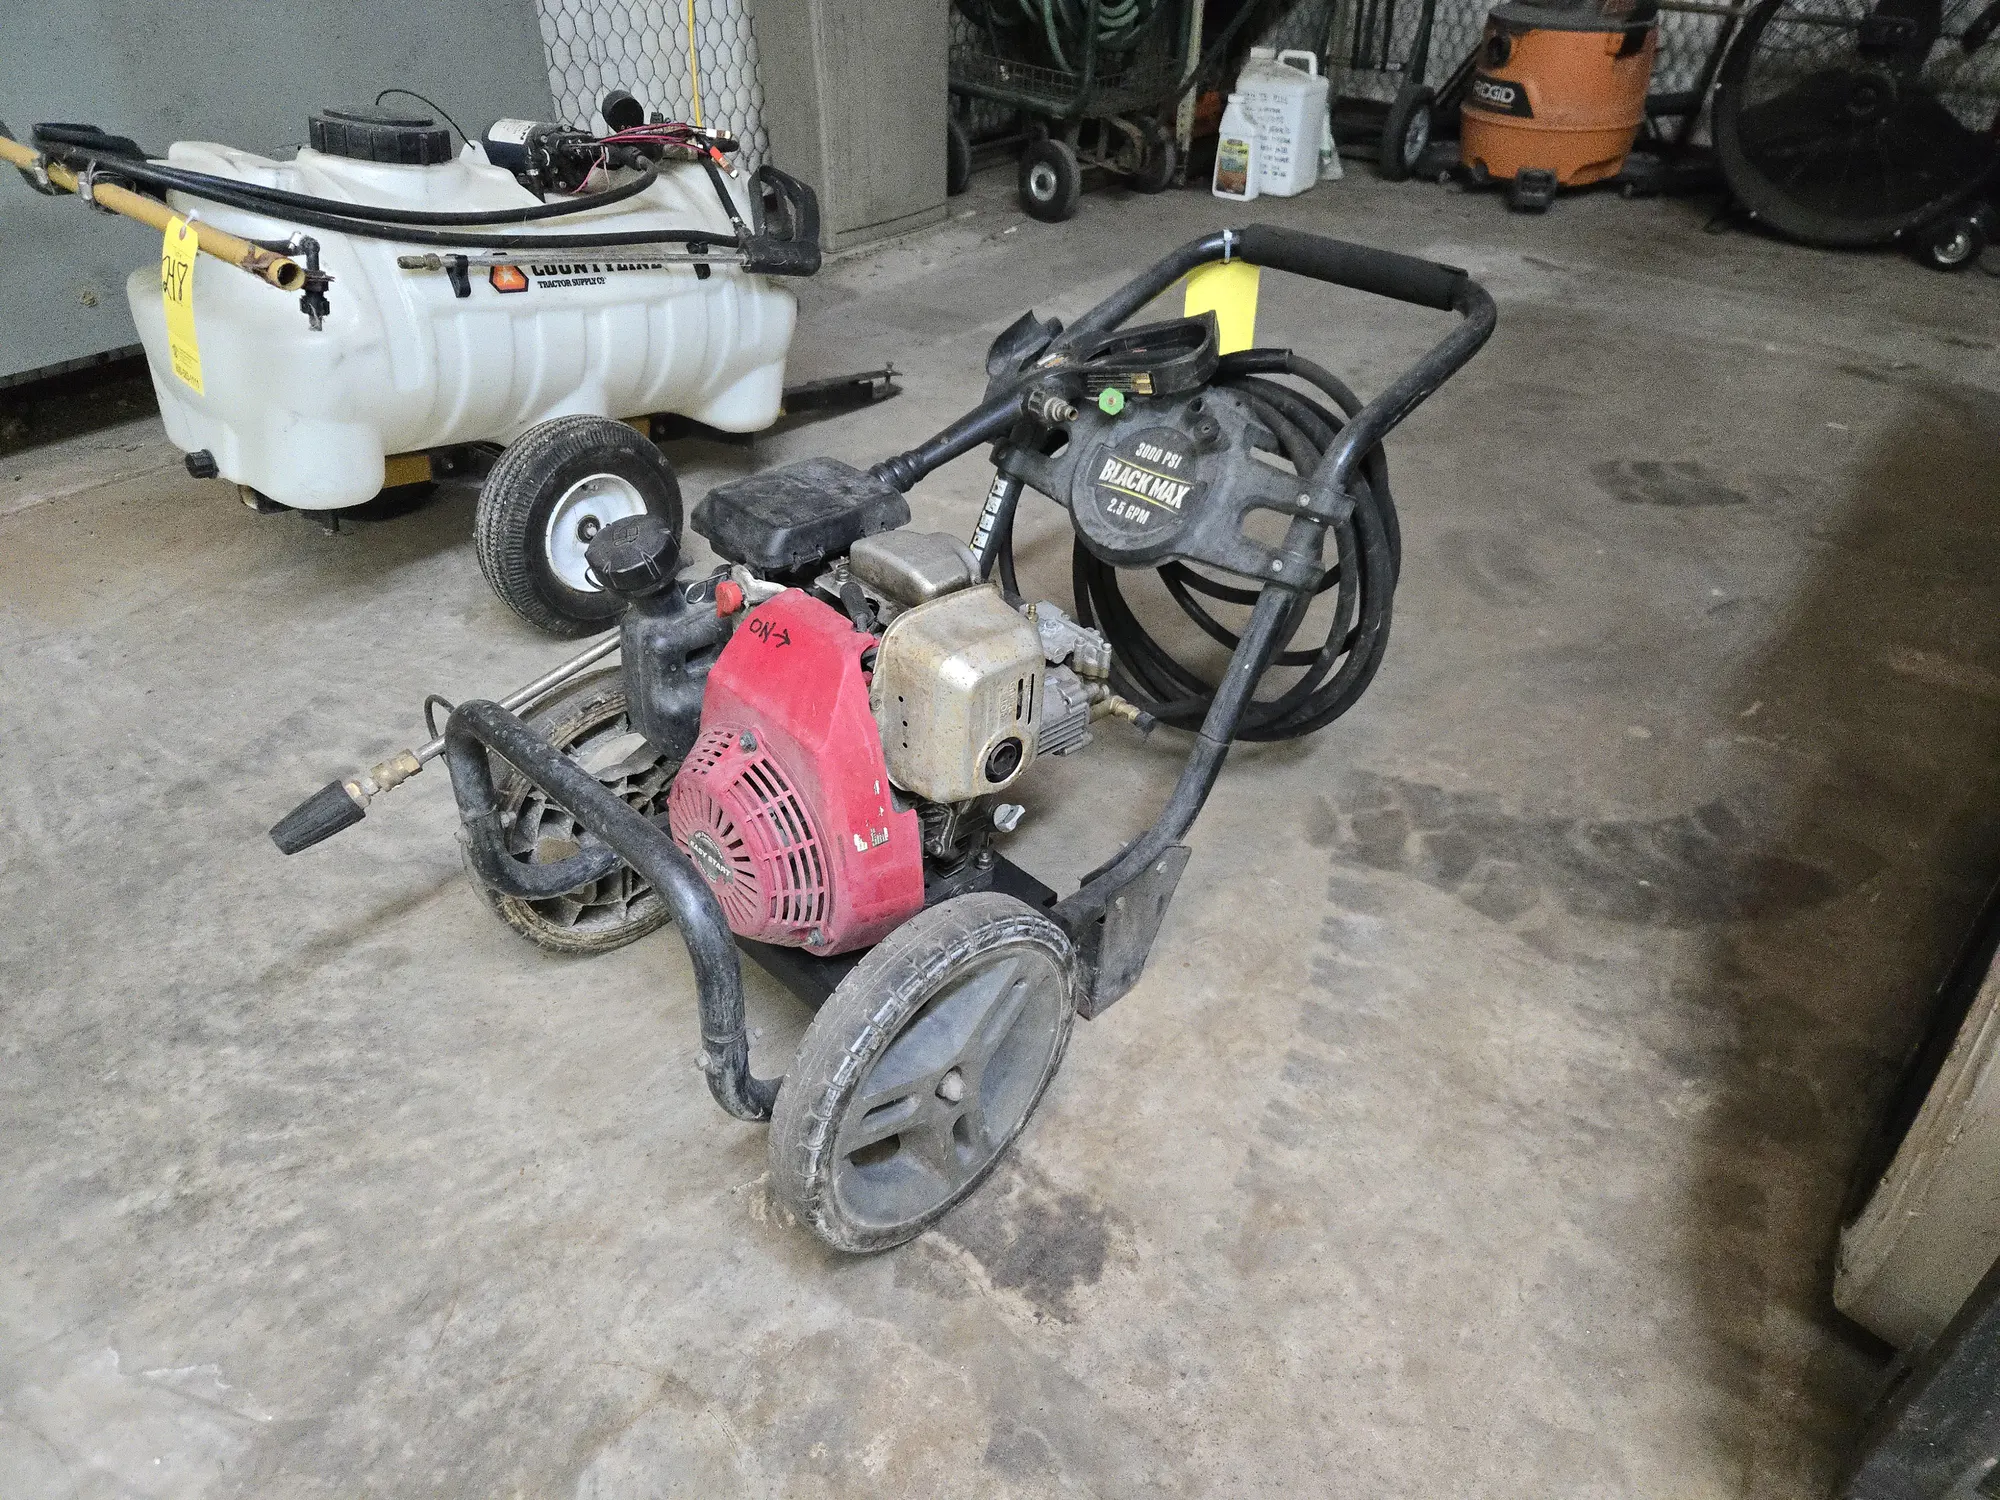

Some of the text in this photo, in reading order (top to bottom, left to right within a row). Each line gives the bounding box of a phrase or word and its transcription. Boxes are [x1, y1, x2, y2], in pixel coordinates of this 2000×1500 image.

[537, 279, 573, 289] TRACTOR
[572, 278, 597, 288] SUPPLY
[1135, 442, 1183, 469] 3000 PSI
[1099, 458, 1191, 509] BLACK MAX
[1107, 498, 1151, 525] 2.5 GPM
[749, 618, 776, 644] ON
[690, 840, 708, 858] EASY
[707, 855, 731, 876] START
